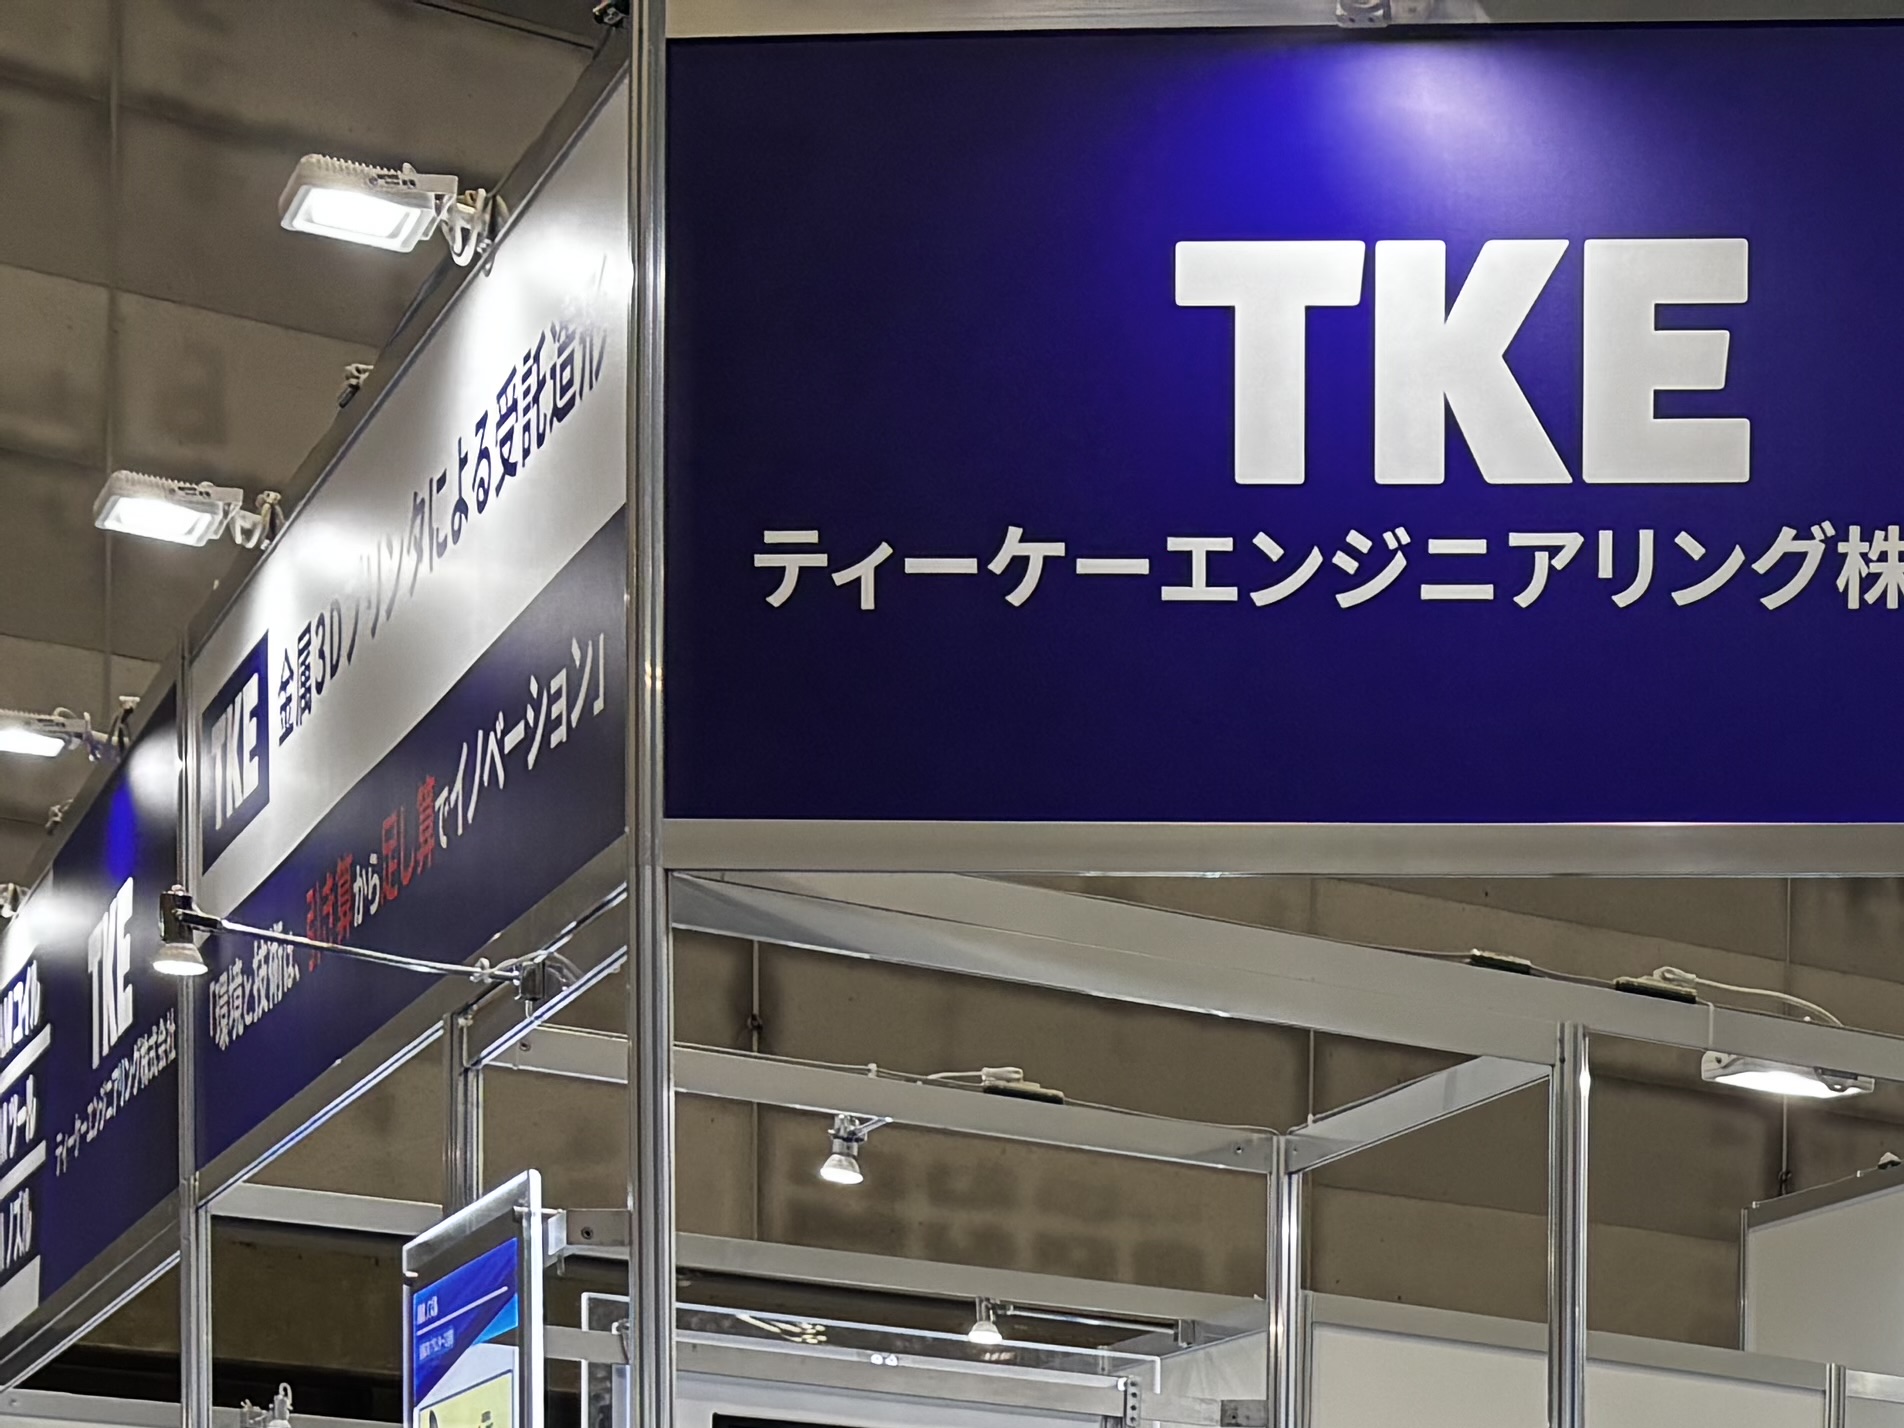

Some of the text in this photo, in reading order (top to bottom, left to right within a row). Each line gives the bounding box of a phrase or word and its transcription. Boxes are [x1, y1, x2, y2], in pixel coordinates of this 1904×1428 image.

[1173, 236, 1751, 486] TKE
[210, 672, 260, 831] TKE
[88, 876, 133, 1069] TKE
